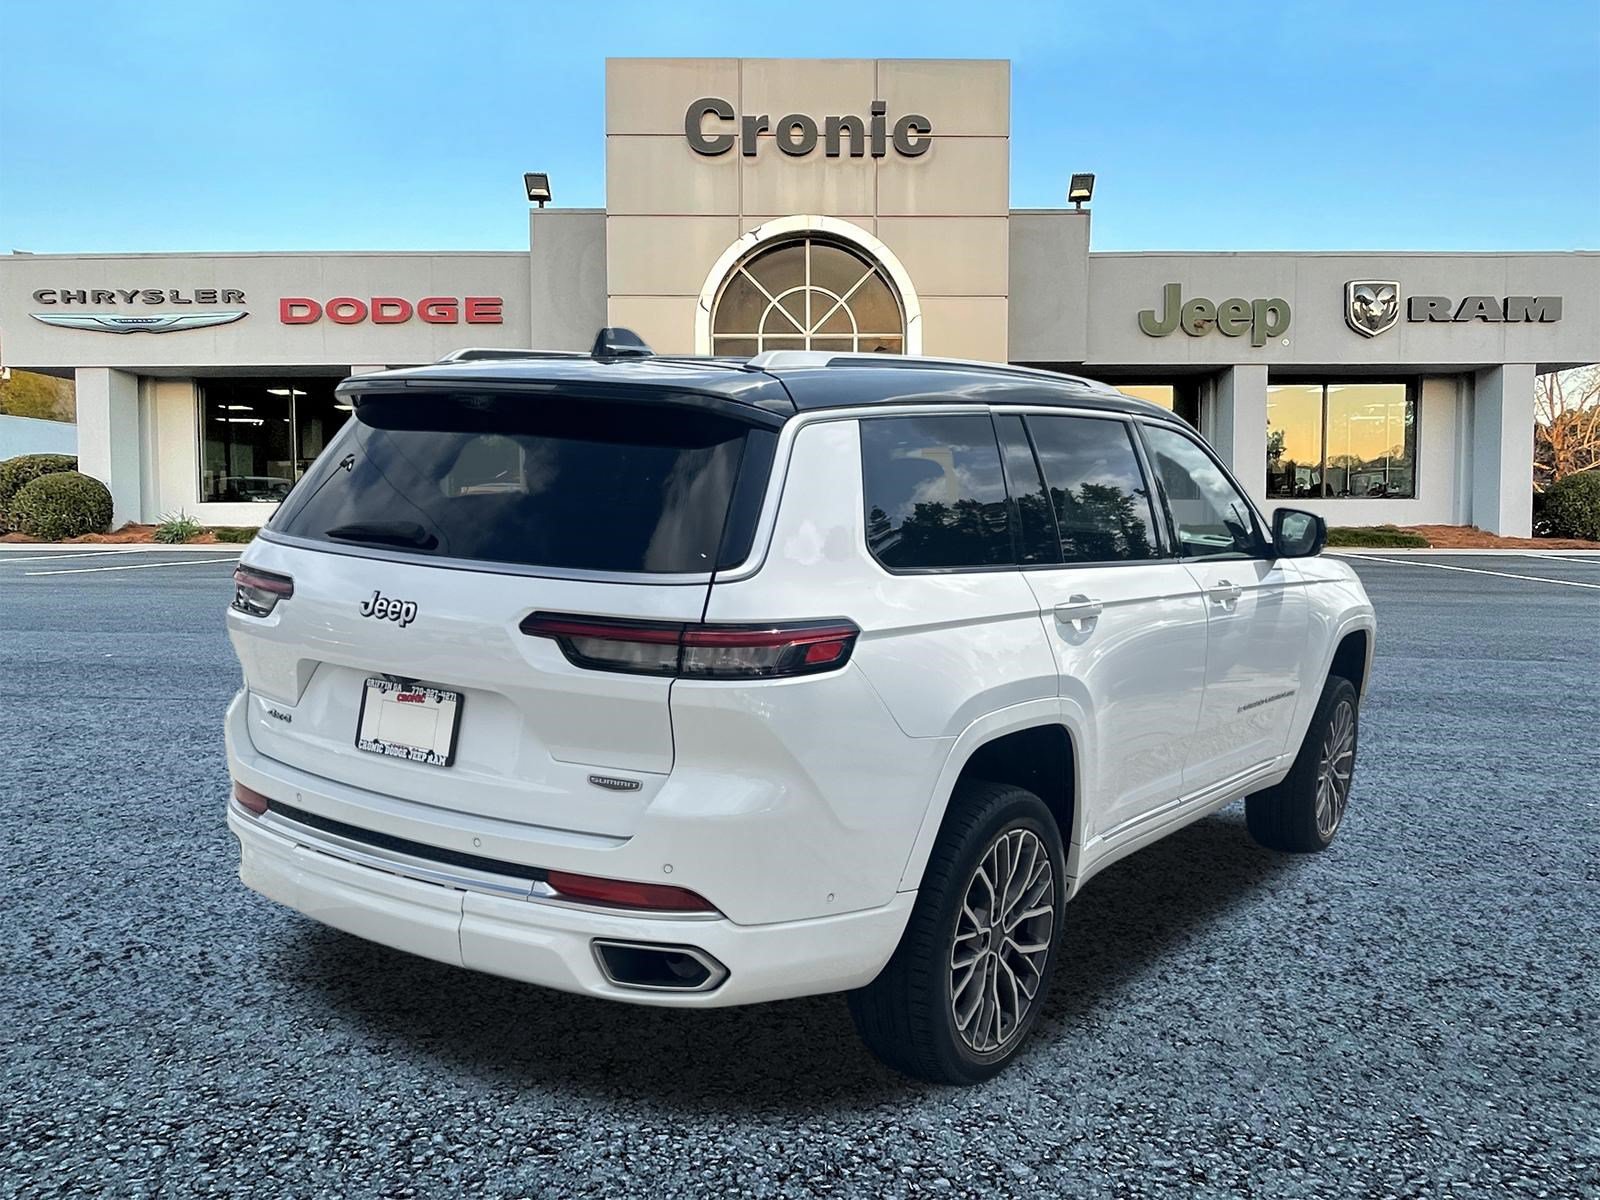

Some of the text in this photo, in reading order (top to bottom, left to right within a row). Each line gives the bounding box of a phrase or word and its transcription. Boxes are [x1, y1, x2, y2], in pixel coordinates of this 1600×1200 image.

[684, 97, 932, 158] Cronic
[32, 289, 247, 305] CHRYSLER
[279, 296, 504, 325] DODGE
[1407, 295, 1563, 324] RAM
[1138, 283, 1292, 347] Jeep
[360, 590, 418, 628] Jeep
[366, 679, 393, 692] GRIFFIN
[358, 740, 384, 754] CRONIC
[384, 744, 408, 759] DODGE
[408, 749, 427, 762] JEEP
[427, 752, 447, 766] RAM
[590, 777, 638, 787] SUMMIT
